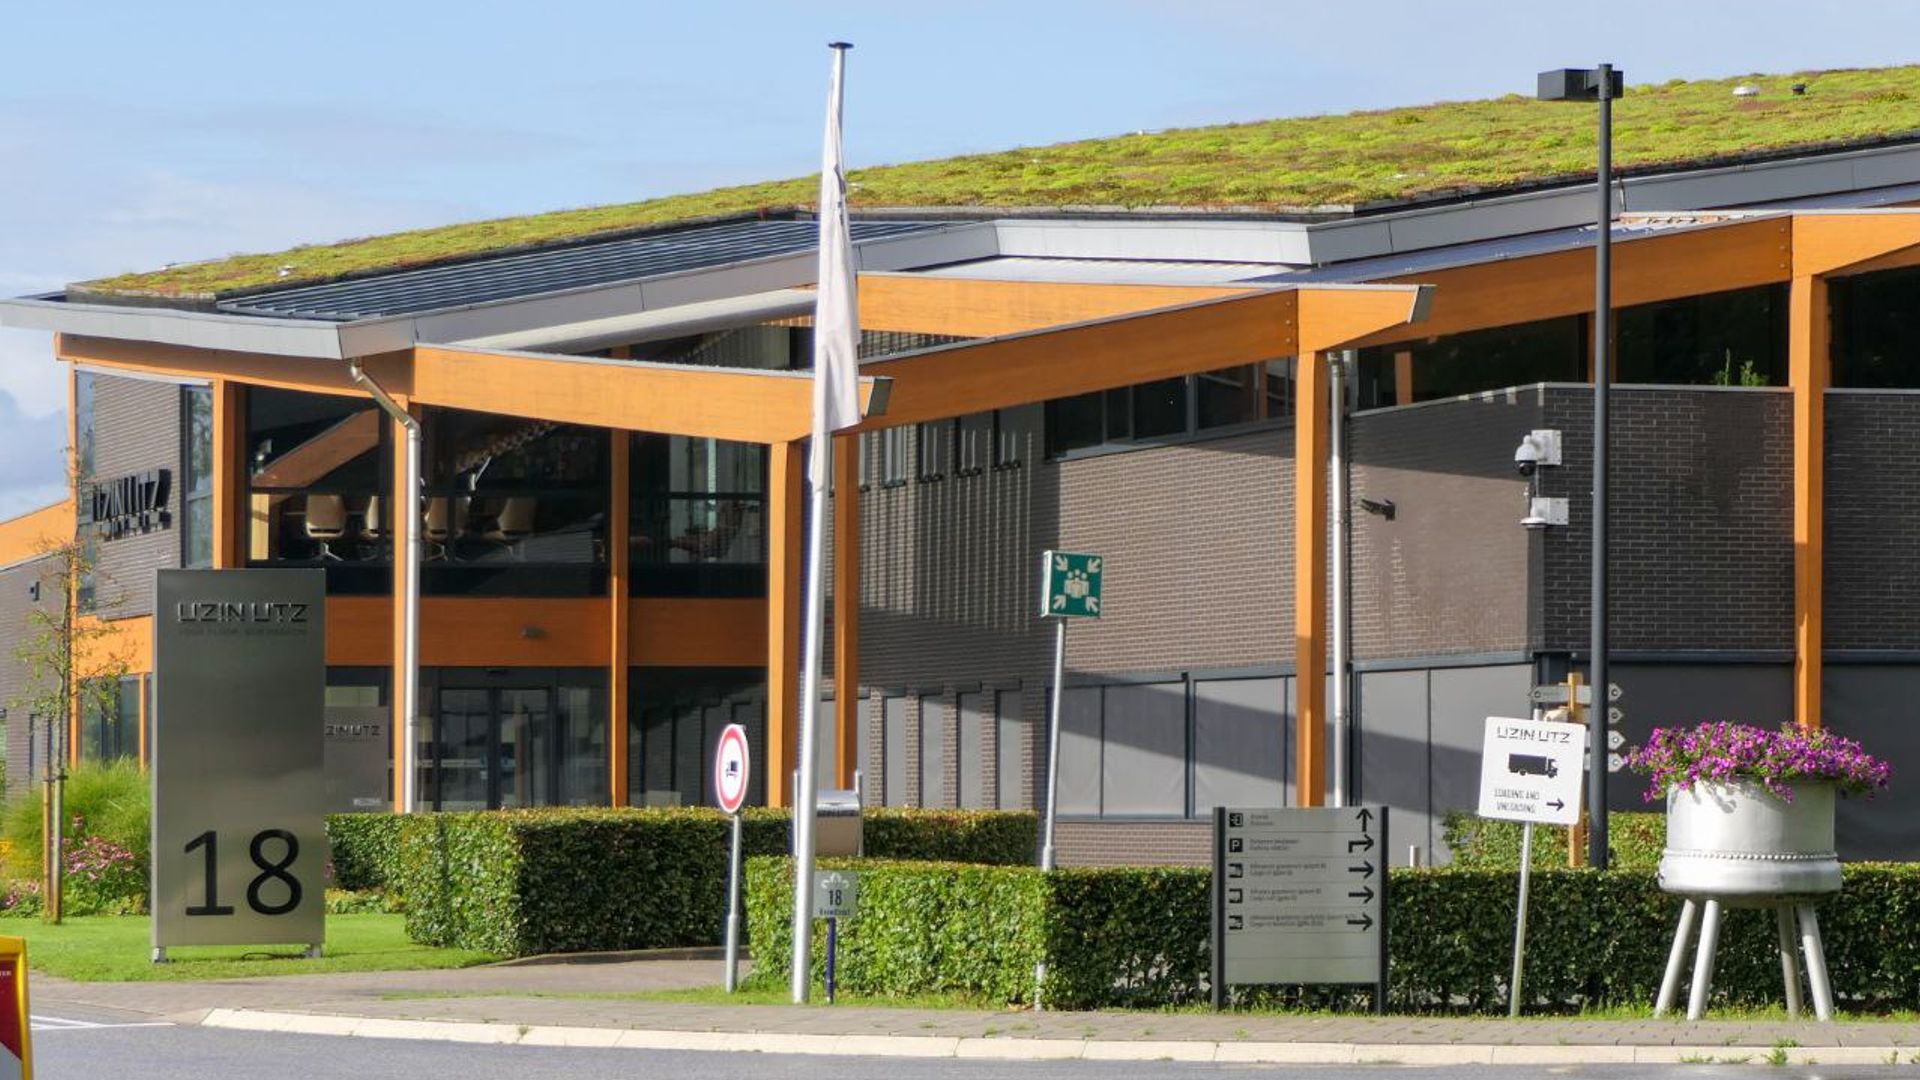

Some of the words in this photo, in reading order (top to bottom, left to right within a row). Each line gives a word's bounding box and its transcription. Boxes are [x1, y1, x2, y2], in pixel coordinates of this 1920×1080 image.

[177, 602, 245, 622] UZIN
[251, 602, 309, 622] UTZ
[325, 725, 348, 736] ZIN
[1497, 726, 1535, 740] UZIN
[1538, 731, 1570, 743] UTZ
[184, 829, 302, 915] 18
[828, 889, 843, 906] 18
